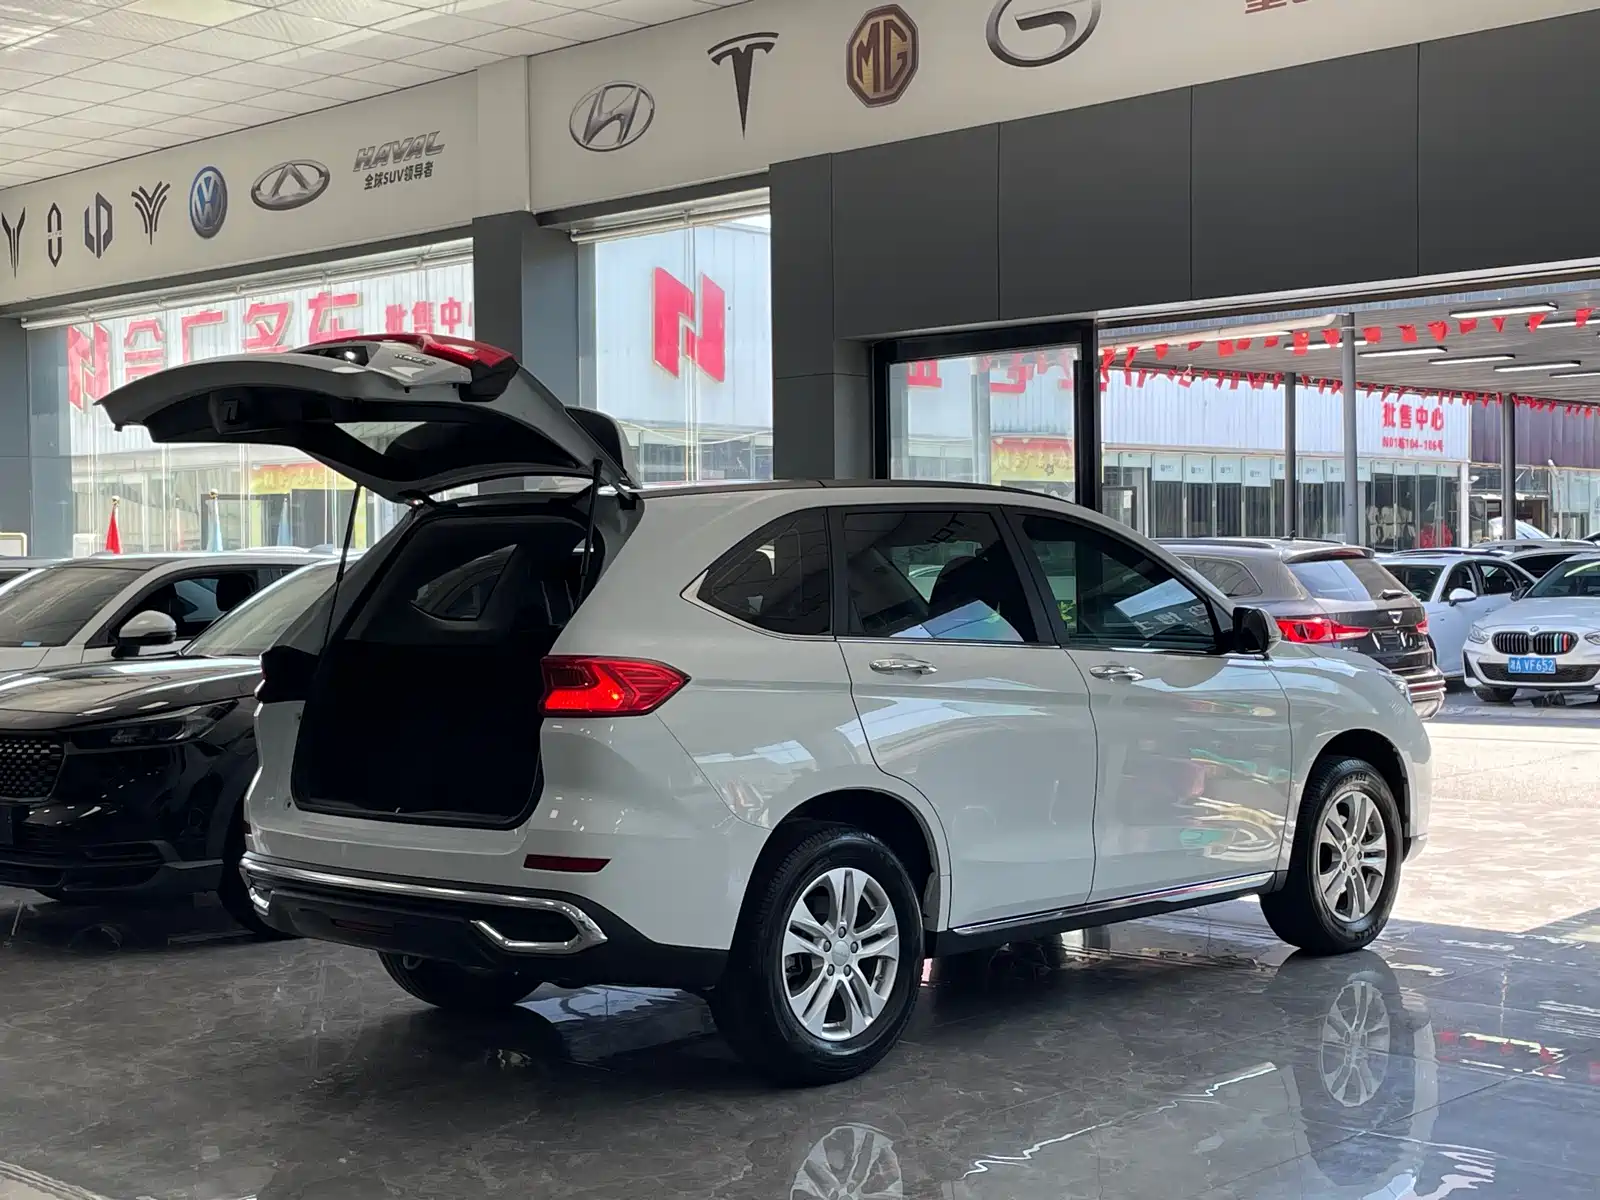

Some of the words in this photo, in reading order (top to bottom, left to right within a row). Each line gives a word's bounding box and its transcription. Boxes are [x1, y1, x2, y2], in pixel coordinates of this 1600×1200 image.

[855, 17, 909, 95] MG
[352, 130, 446, 173] HAVAL
[363, 160, 434, 191] 全球SUV领导者
[1382, 402, 1444, 431] 批售中心
